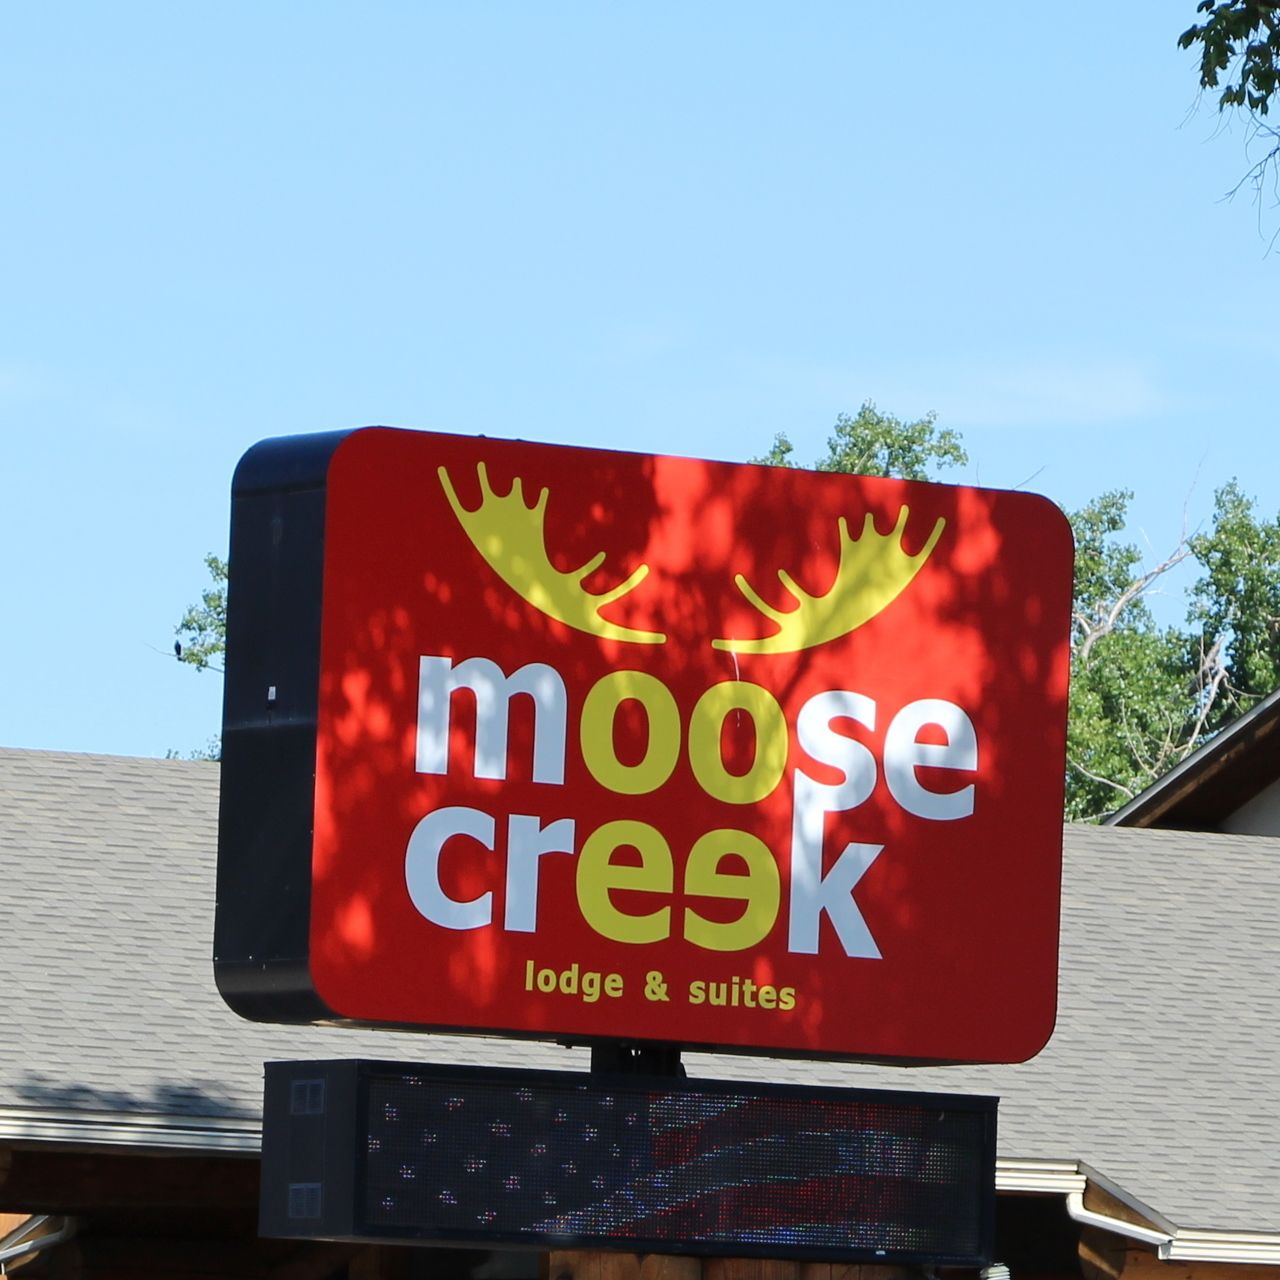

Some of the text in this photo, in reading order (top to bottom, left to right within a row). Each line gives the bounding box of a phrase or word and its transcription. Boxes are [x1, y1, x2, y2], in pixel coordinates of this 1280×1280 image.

[415, 655, 978, 821] moose
[405, 805, 884, 960] creek
[525, 960, 796, 1011] lodge & suites
